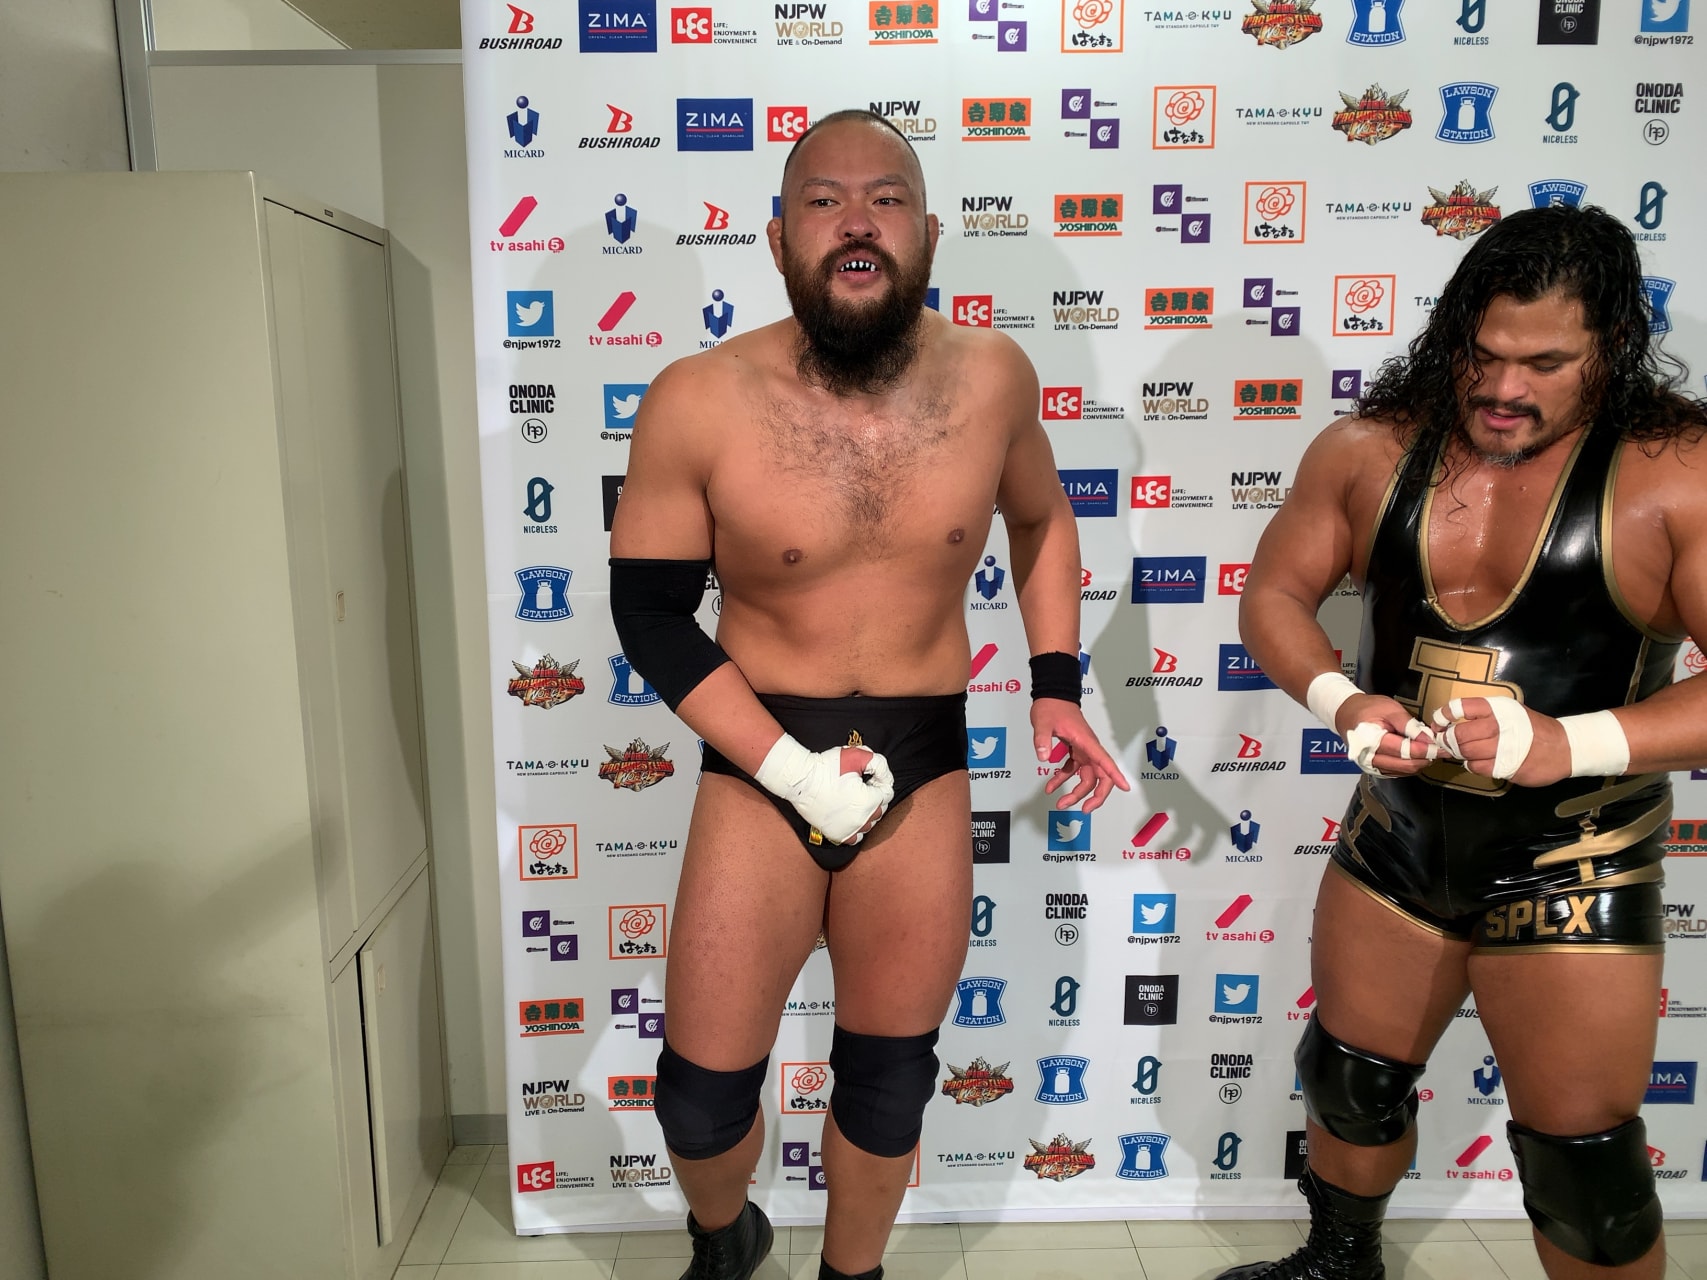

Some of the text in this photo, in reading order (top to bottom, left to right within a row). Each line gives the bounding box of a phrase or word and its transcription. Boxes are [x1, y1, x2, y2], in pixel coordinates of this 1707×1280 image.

[775, 3, 826, 20] NJPW
[1555, 4, 1584, 14] CLINIC
[588, 13, 648, 28] ZIMA
[677, 12, 709, 40] LEC
[777, 38, 842, 46] LIVE On-Demand
[1353, 31, 1401, 43] STATION
[1634, 35, 1694, 46] @njpw1972
[479, 38, 563, 50] BUSHIROAD
[1445, 86, 1493, 99] LAWSON
[1636, 83, 1684, 98] ONODA
[869, 101, 920, 117] NJPW
[1635, 98, 1681, 114] CLINIC
[686, 112, 744, 127] ZIMA
[772, 111, 805, 139] LEC
[1442, 128, 1490, 141] STATION
[578, 136, 660, 149] BUSHIROAD
[504, 149, 545, 159] MICARD
[1533, 183, 1582, 196] LAWSON
[962, 196, 1013, 212] NJPW
[676, 233, 757, 246] BUSHIROAD
[490, 240, 505, 252] tv
[508, 240, 545, 252] asahi
[602, 246, 643, 255] MICARD
[1053, 290, 1104, 306] NJPW
[958, 300, 989, 325] LEC
[1078, 323, 1118, 331] On-Demand
[503, 339, 561, 350] @njpw1972
[589, 335, 603, 346] tv
[606, 334, 643, 346] asahi
[508, 384, 556, 399] ONODA
[1143, 382, 1194, 397] NJPW
[509, 399, 555, 414] CLINIC
[1047, 391, 1079, 417] LEC
[1231, 471, 1282, 487] NJPW
[1136, 481, 1167, 504] LEC
[520, 569, 567, 582] LAWSON
[1140, 568, 1196, 582] ZIMA
[521, 607, 567, 618] STATION
[970, 602, 1008, 611] MICARD
[969, 681, 1002, 693] asahi
[1125, 676, 1203, 688] BUSHIROAD
[615, 692, 659, 703] STATION
[1310, 741, 1347, 753] ZIM
[1211, 761, 1287, 773] BUSHIROAD
[1140, 772, 1180, 781] MICARD
[1042, 853, 1096, 863] @njpw1972
[1122, 850, 1136, 860] tv
[1139, 849, 1173, 860] asahi
[1225, 855, 1263, 863] MICARD
[1045, 893, 1089, 906] ONODA
[1045, 906, 1087, 920] CLINIC
[1485, 895, 1597, 940] SPLX
[1127, 935, 1181, 945] @njpw1972
[1206, 932, 1219, 941] tv
[1222, 931, 1257, 942] asahi
[958, 980, 1002, 991] LAWSON
[1138, 985, 1165, 993] ONODA
[1138, 992, 1164, 1001] CLINIC
[958, 1015, 1001, 1025] STATION
[1209, 1014, 1263, 1025] @njpw1972
[1041, 1058, 1085, 1069] LAWSON
[1210, 1053, 1253, 1066] ONODA
[1210, 1066, 1251, 1079] CLINIC
[522, 1080, 570, 1096] NJPW
[1041, 1092, 1083, 1101] STATION
[1467, 1097, 1504, 1106] MICARD
[1121, 1136, 1165, 1146] LAWSON
[610, 1154, 656, 1168] NJPW
[523, 1167, 551, 1188] LEC
[1122, 1168, 1163, 1177] STATION
[1447, 1169, 1459, 1179] tv
[1462, 1169, 1495, 1180] asahi
[634, 1180, 671, 1188] On-Demand
